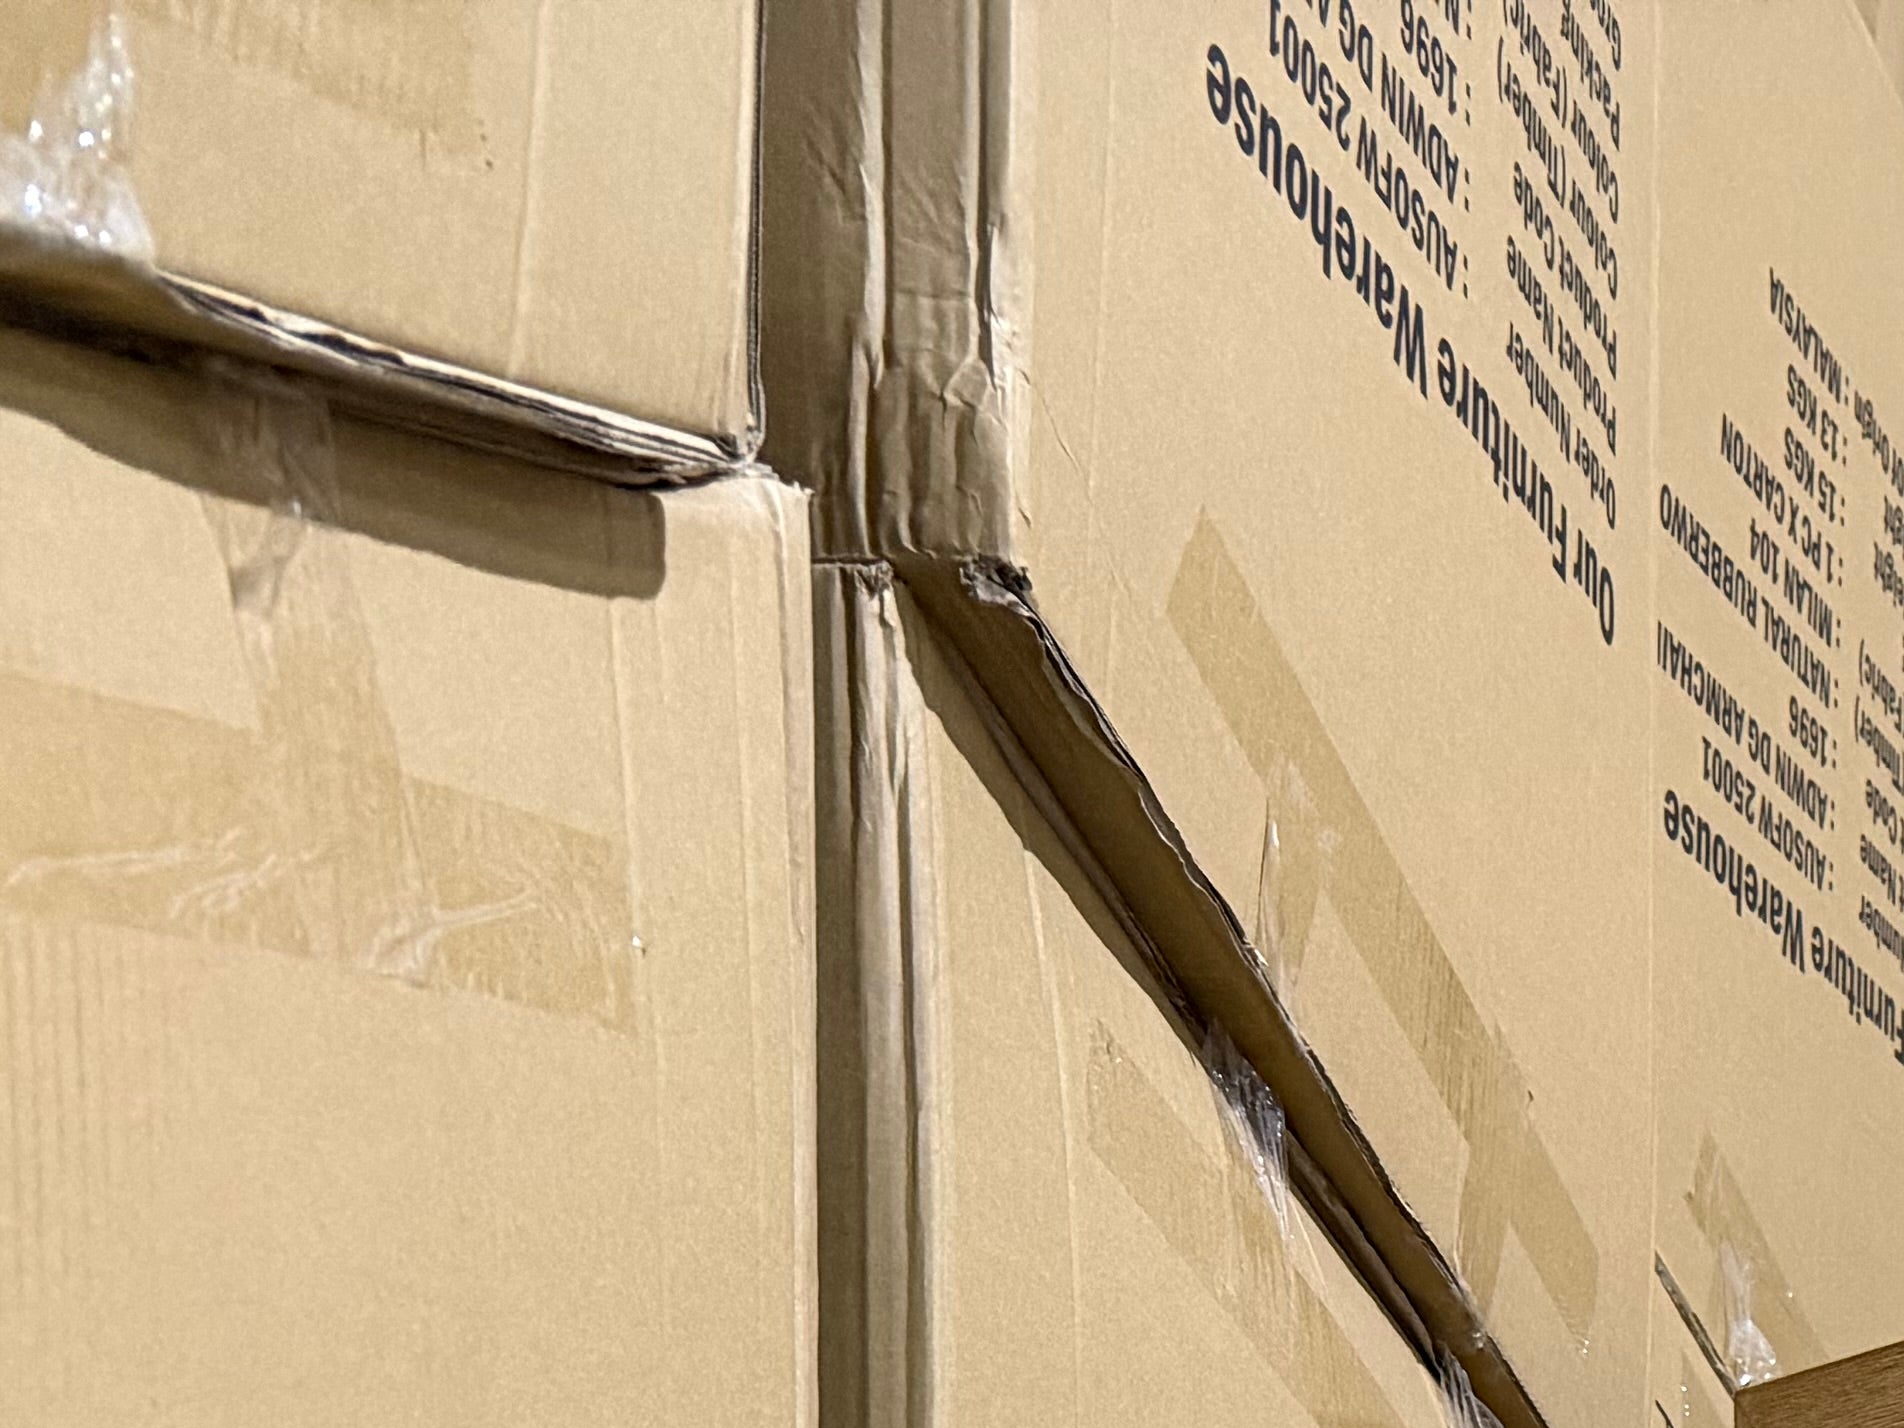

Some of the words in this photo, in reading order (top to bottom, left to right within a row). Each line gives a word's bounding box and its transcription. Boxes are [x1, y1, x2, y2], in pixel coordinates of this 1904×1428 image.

[1356, 116, 1458, 291] AUSOFW
[1381, 53, 1459, 204] ADWIN
[1206, 44, 1428, 400] Warehouse
[1769, 267, 1841, 403] MALAYSIA
[1438, 338, 1567, 583] Furniture
[1573, 529, 1614, 646] Our
[1664, 789, 1805, 973] Warehouse
